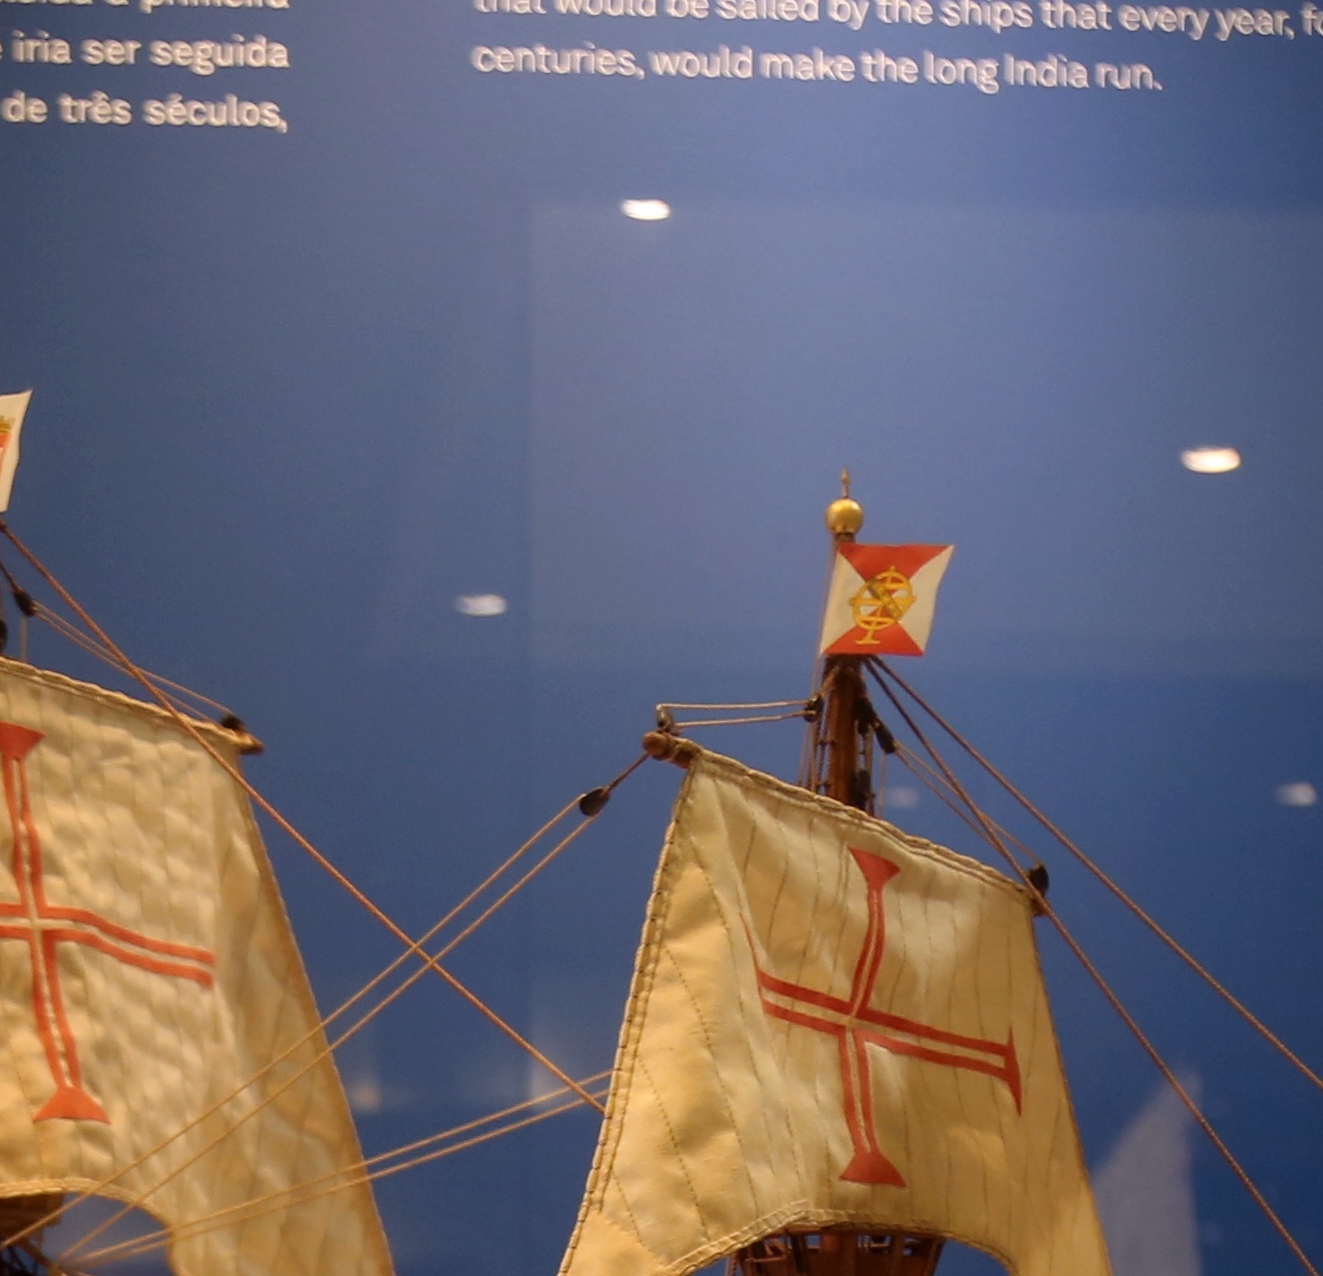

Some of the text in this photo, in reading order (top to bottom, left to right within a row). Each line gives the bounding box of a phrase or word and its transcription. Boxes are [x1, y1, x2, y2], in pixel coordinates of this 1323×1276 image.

[716, 0, 819, 21] sailed
[828, 0, 869, 30] by
[876, 0, 933, 24] the
[939, 0, 1032, 33] ships
[1039, 0, 1112, 30] that
[1118, 5, 1209, 40] every
[1214, 8, 1294, 41] year,
[13, 31, 72, 63] iria
[82, 40, 140, 64] ser
[150, 34, 290, 75] seguida
[472, 45, 1162, 94] centuries, would make the long India run.
[1, 91, 47, 123] de
[58, 91, 131, 124] três
[144, 94, 288, 133] séculos,
